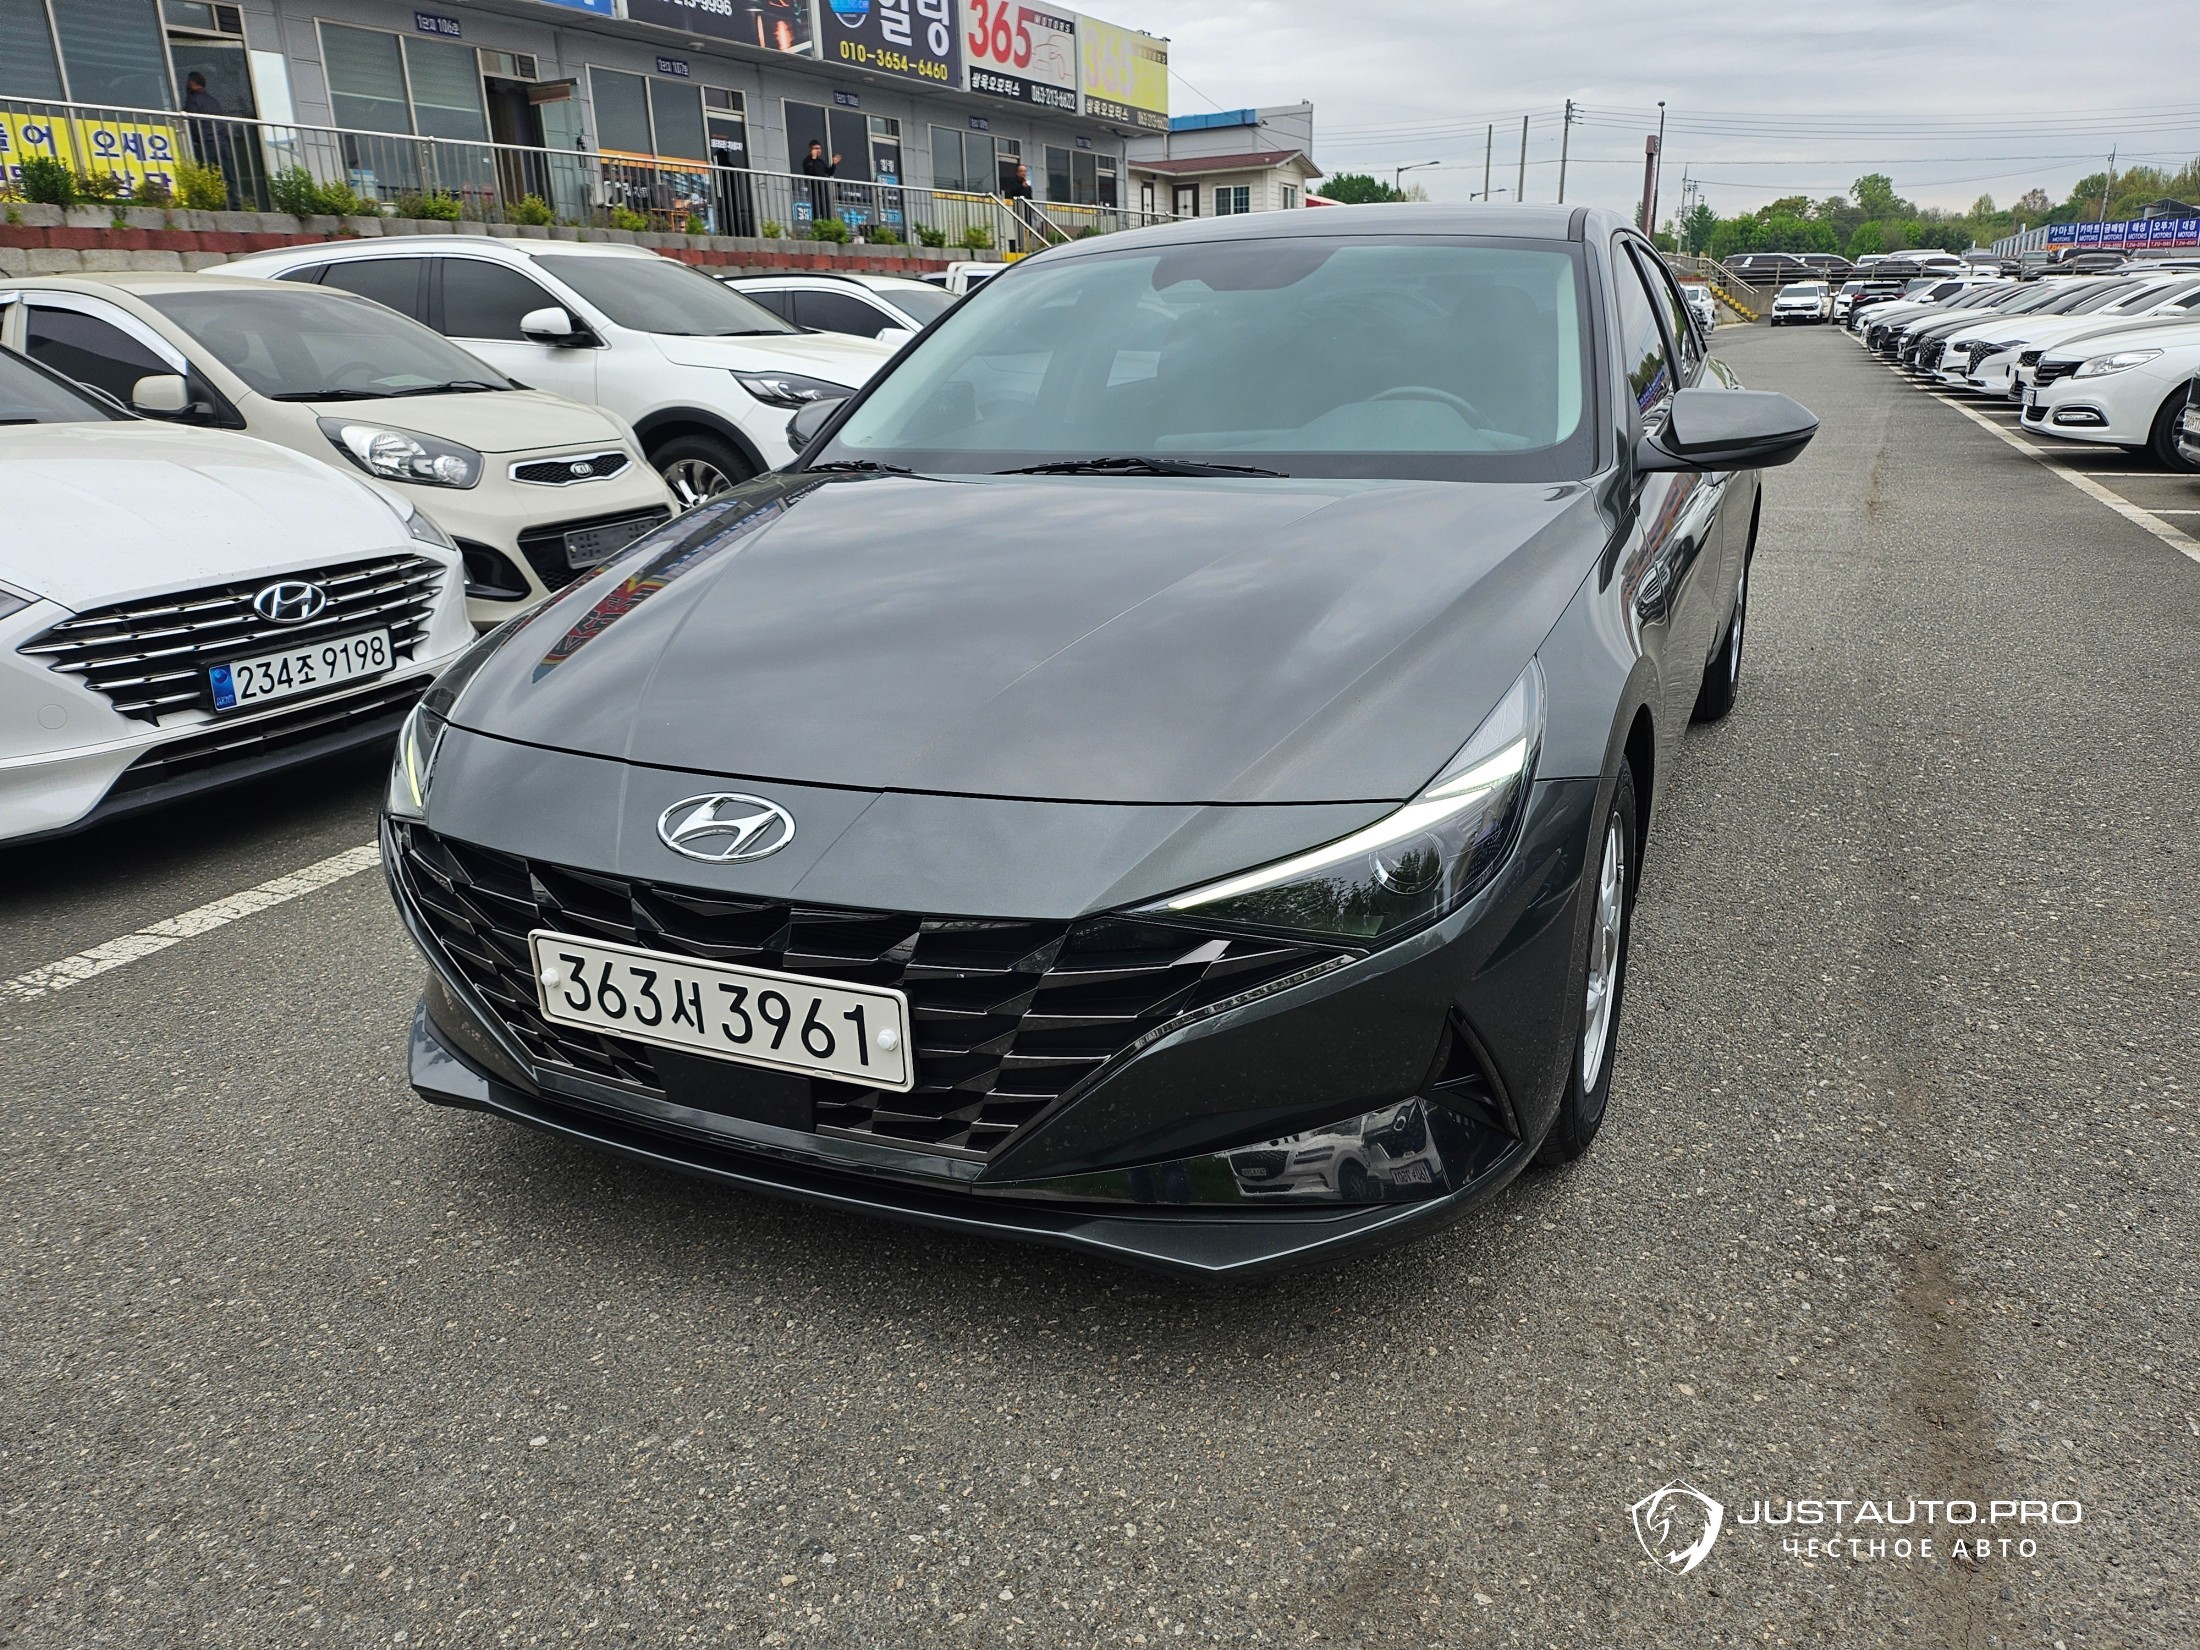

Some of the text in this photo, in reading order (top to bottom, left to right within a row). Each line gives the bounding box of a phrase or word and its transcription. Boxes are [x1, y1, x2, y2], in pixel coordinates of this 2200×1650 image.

[1034, 14, 1071, 33] MOTORS
[968, 0, 1032, 68] 365
[840, 40, 948, 80] 010-3654-6460
[1084, 27, 1134, 98] 365
[93, 130, 173, 161] 오세요
[2050, 225, 2075, 236] 카마트
[2080, 223, 2100, 234] 카마트
[2152, 231, 2172, 239] MOTORS
[2153, 221, 2175, 231] 오뚜기
[2128, 232, 2147, 240] MOTORS
[237, 636, 385, 700] 234조 9198
